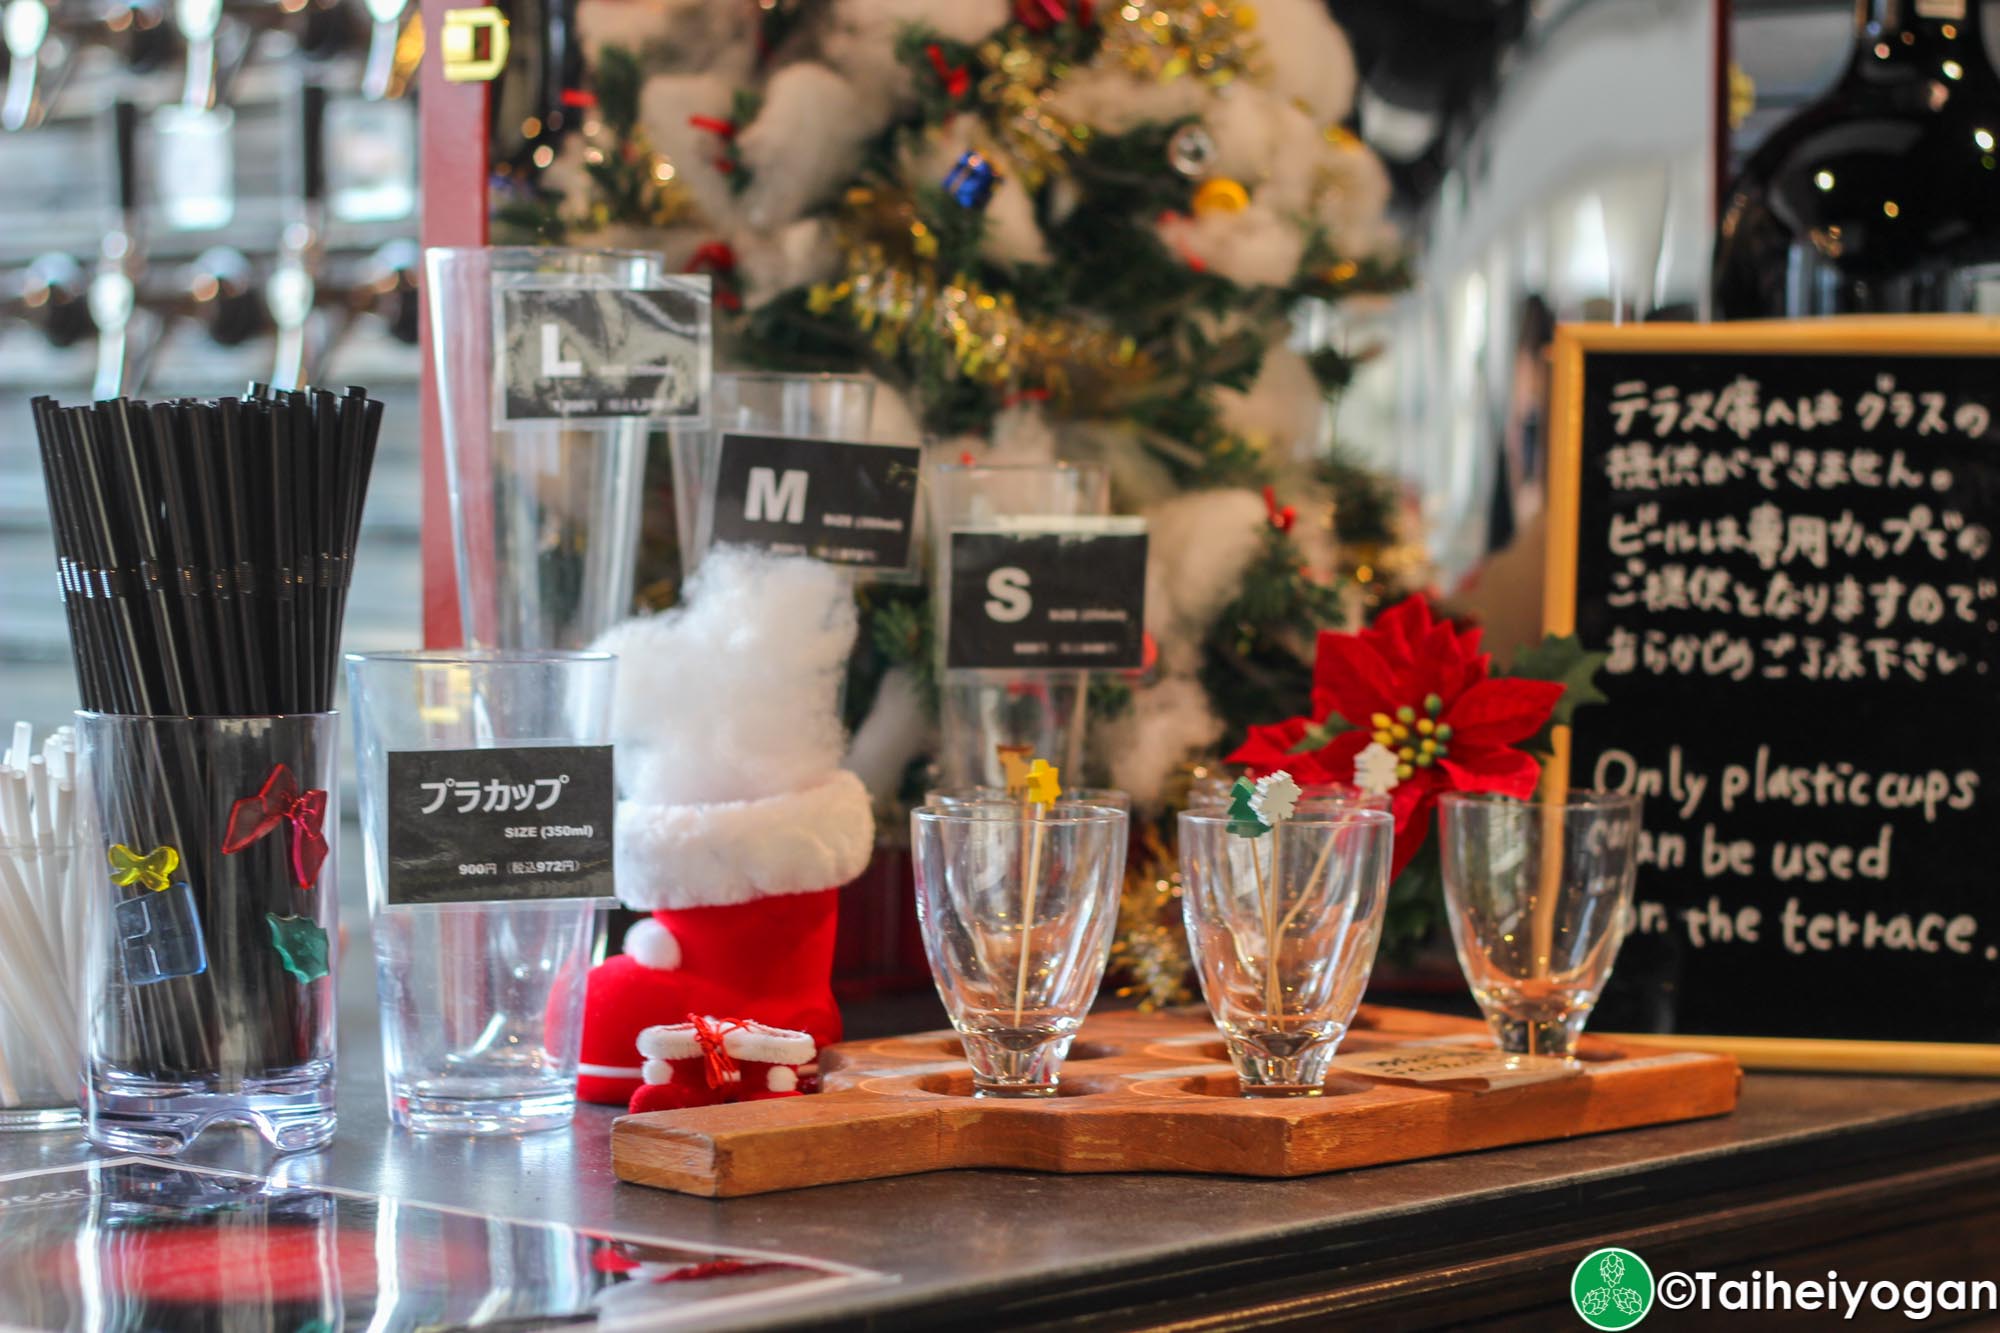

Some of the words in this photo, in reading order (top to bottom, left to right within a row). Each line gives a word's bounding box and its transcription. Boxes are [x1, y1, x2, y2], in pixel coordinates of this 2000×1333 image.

[541, 323, 582, 377] L
[744, 467, 809, 524] M
[985, 567, 1032, 622] S
[420, 774, 570, 814] プラカップ
[1594, 745, 1706, 819] Only
[1721, 744, 1871, 811] plastic
[1875, 769, 1980, 822] cups
[504, 826, 538, 839] SIZE
[540, 824, 594, 840] (350ml)
[1702, 824, 1755, 877] be
[1771, 824, 1893, 882] used
[458, 862, 497, 876] 900円
[1683, 897, 1762, 948] the
[1780, 897, 1998, 961] terrace.
